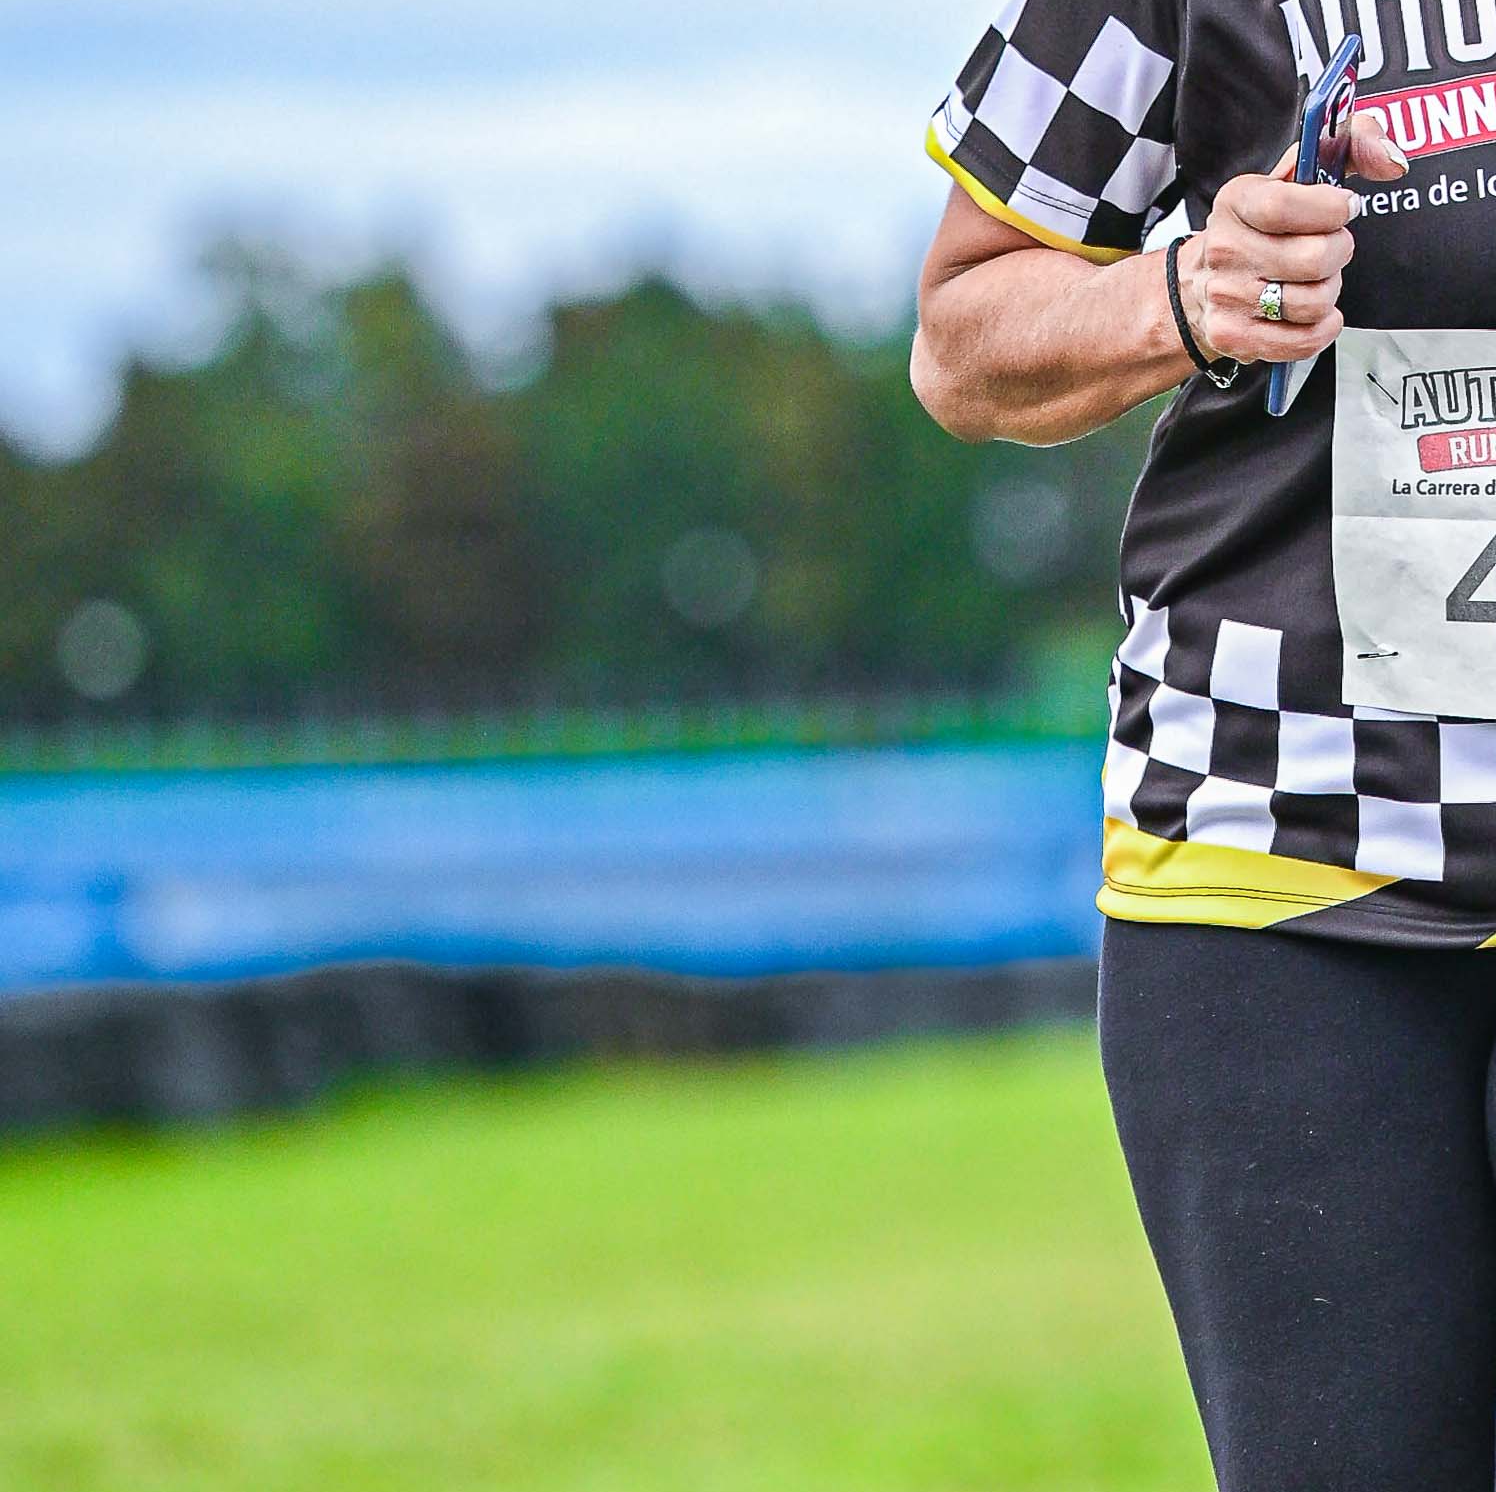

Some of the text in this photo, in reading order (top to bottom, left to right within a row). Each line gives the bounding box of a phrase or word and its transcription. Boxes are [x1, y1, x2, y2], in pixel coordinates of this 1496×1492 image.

[1360, 187, 1420, 218] rera
[1428, 174, 1469, 207] de
[1392, 479, 1411, 495] La
[1416, 479, 1480, 496] Carrera
